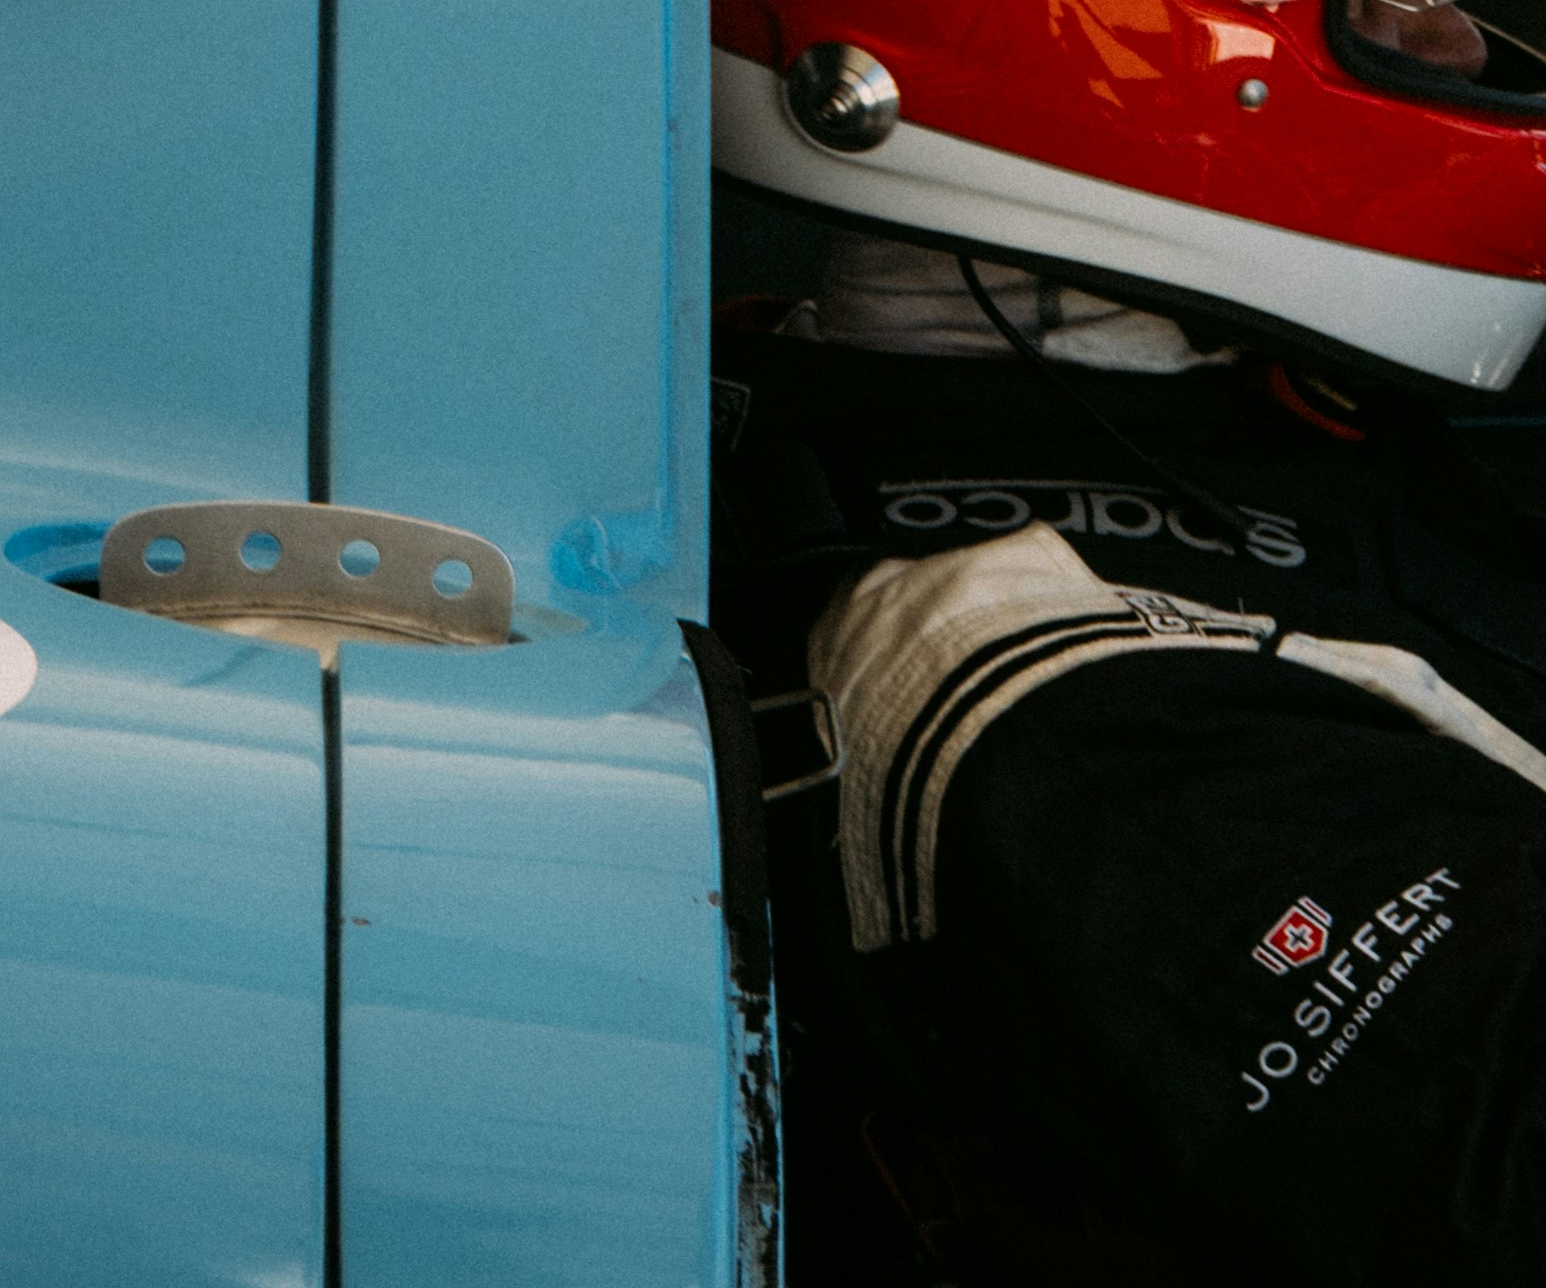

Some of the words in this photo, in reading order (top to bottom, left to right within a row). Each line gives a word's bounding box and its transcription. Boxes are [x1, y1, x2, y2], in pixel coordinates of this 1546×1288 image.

[1241, 1040, 1298, 1111] JO
[1294, 867, 1462, 1038] SIFFERT
[1306, 913, 1454, 1086] CHRONOGRAPHS
